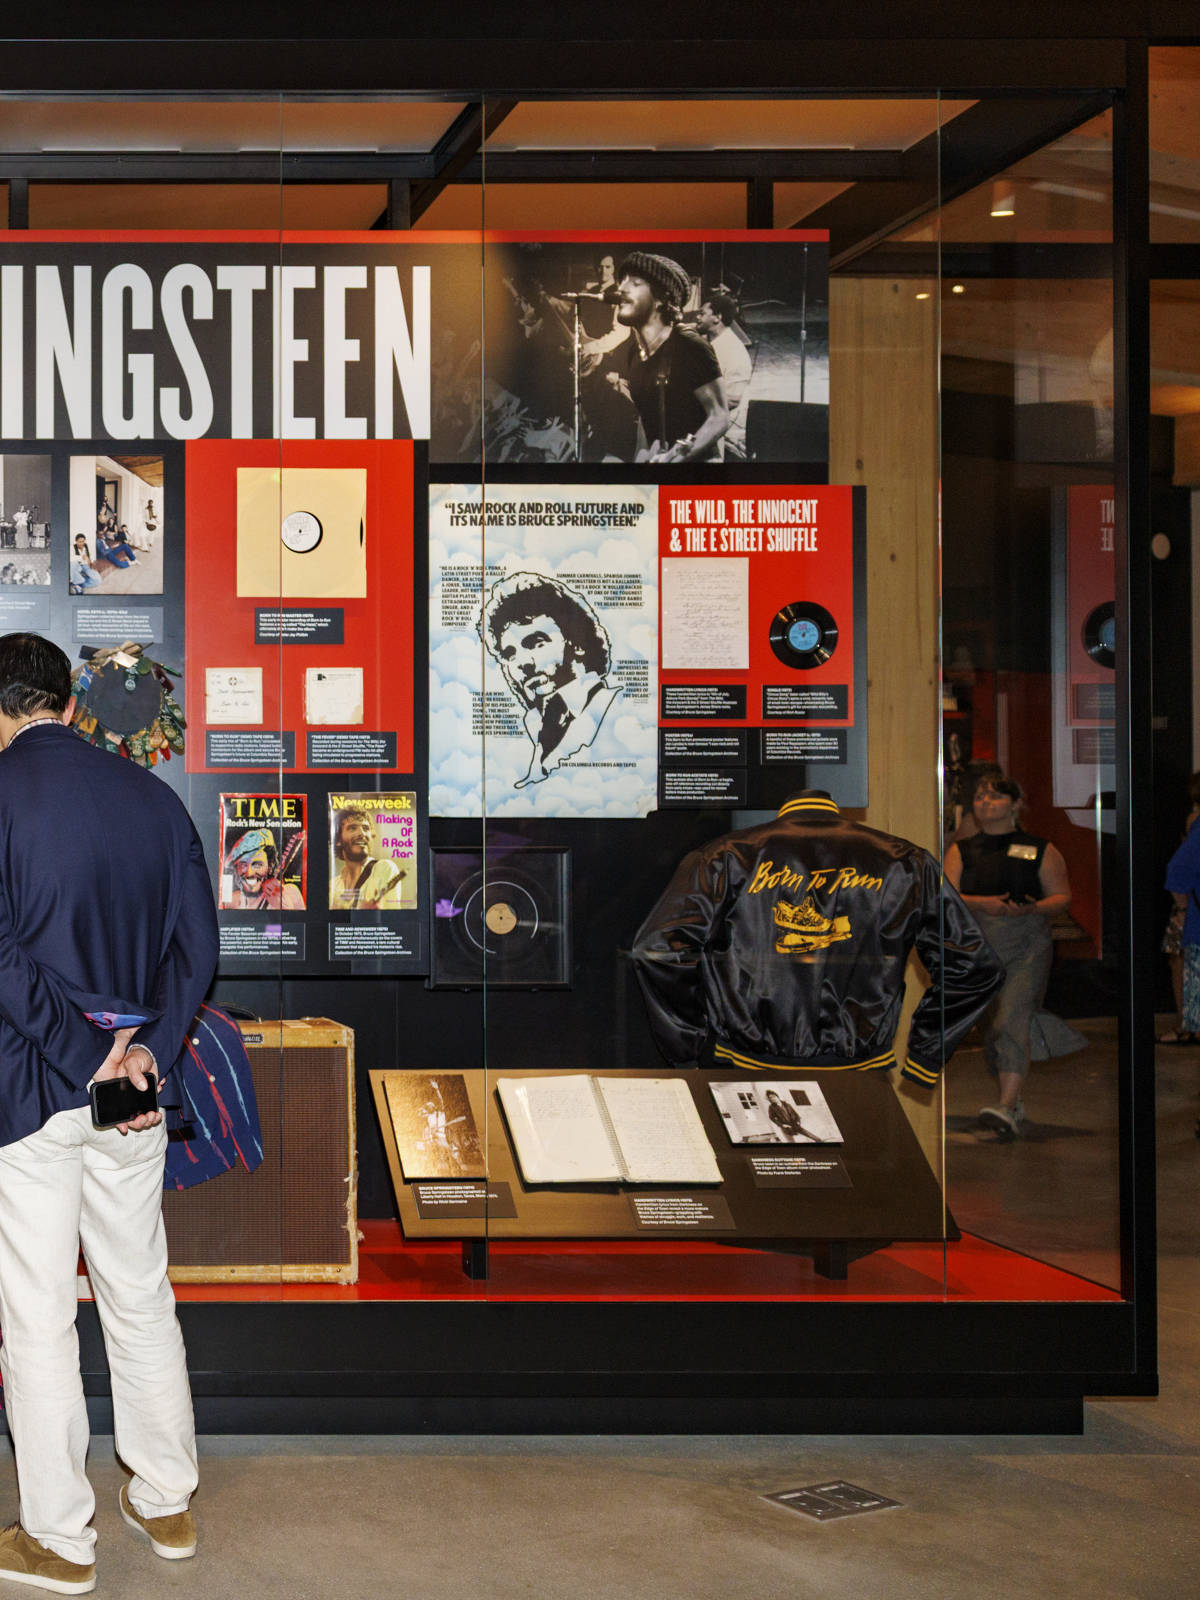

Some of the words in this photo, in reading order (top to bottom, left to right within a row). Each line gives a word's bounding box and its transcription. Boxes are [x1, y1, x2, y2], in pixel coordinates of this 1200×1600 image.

[458, 503, 482, 514] SAW
[485, 503, 516, 514] ROCK
[519, 503, 543, 514] AND
[545, 503, 573, 514] ROLL
[576, 503, 618, 514] FUTURE
[620, 503, 644, 514] AND
[670, 499, 692, 524] THE
[694, 499, 730, 524] WILD,
[732, 499, 755, 524] THE
[758, 499, 818, 524] INNOCENT
[450, 515, 467, 526] ITS
[470, 515, 504, 526] NAME
[506, 515, 516, 526] IS
[519, 515, 554, 526] BRUCE
[670, 528, 682, 552] &
[684, 528, 707, 552] THE
[710, 528, 718, 552] E
[720, 528, 764, 552] STREET
[767, 528, 818, 552] SHUFFLE
[231, 798, 296, 818] TIME
[332, 796, 411, 809] Newsweek
[249, 818, 265, 827] New
[266, 818, 302, 827] Senation
[376, 814, 413, 826] Making
[391, 838, 413, 847] Rock
[392, 849, 413, 858] Star
[748, 860, 804, 894] Born
[806, 868, 836, 892] To
[828, 867, 883, 895] Run
